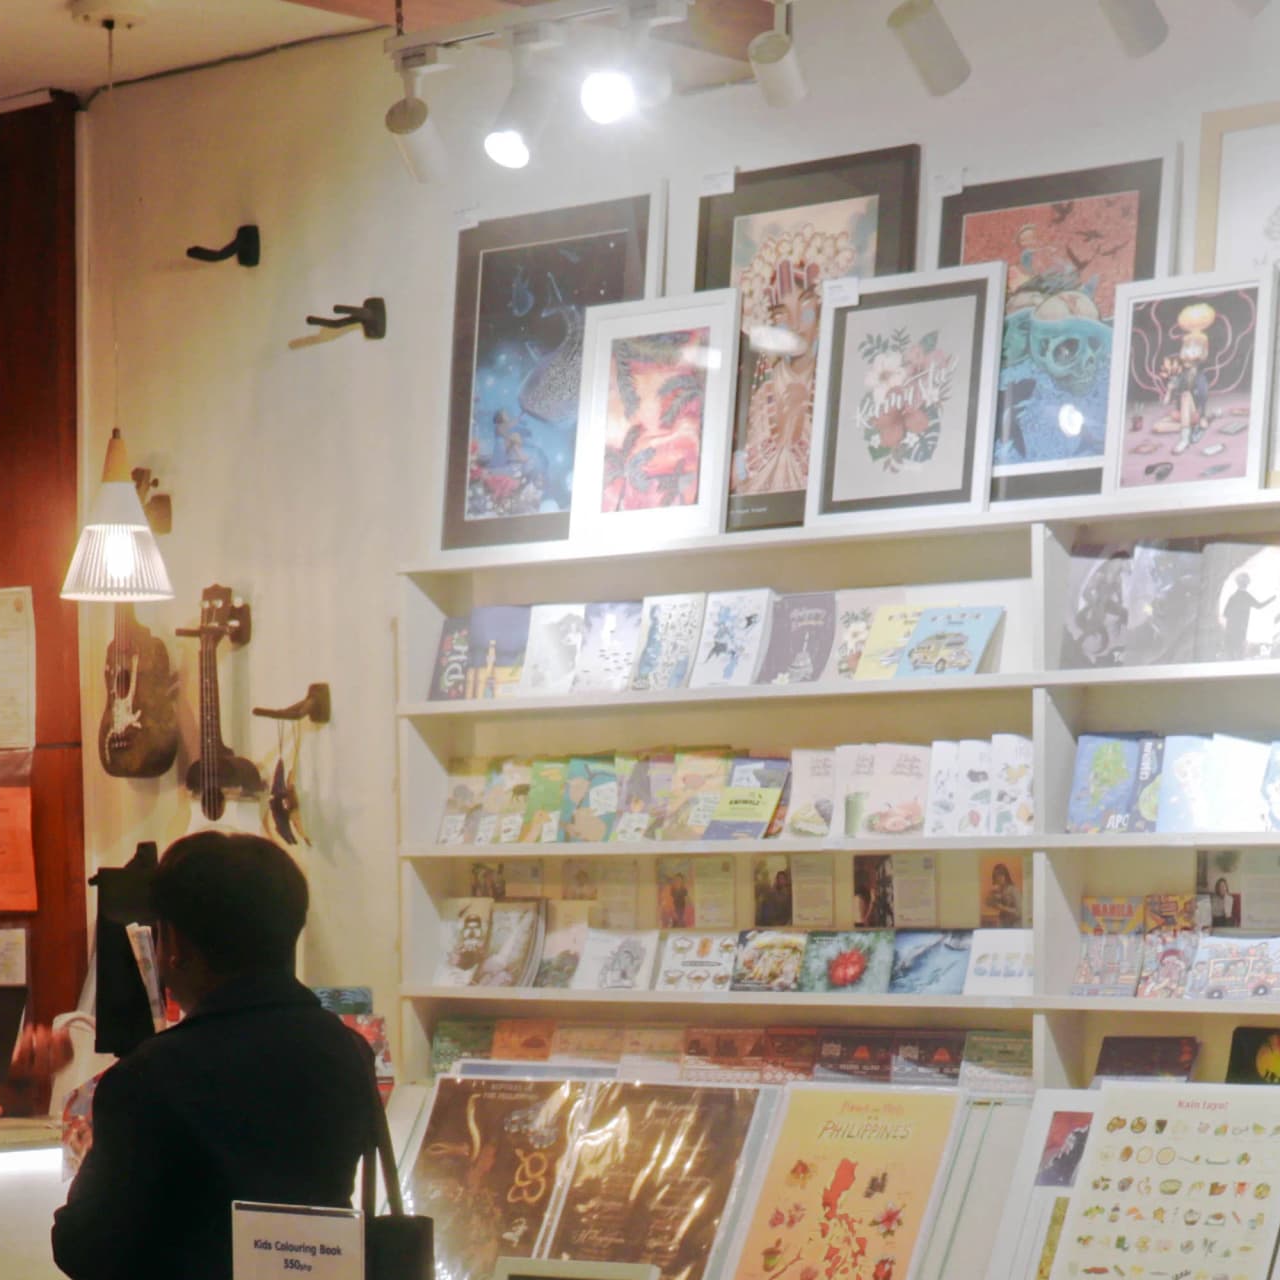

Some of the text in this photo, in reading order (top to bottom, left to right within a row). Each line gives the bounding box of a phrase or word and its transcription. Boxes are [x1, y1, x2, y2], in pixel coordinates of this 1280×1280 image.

[1092, 903, 1136, 919] MANILA
[253, 1239, 342, 1257] Kids Colouring Book
